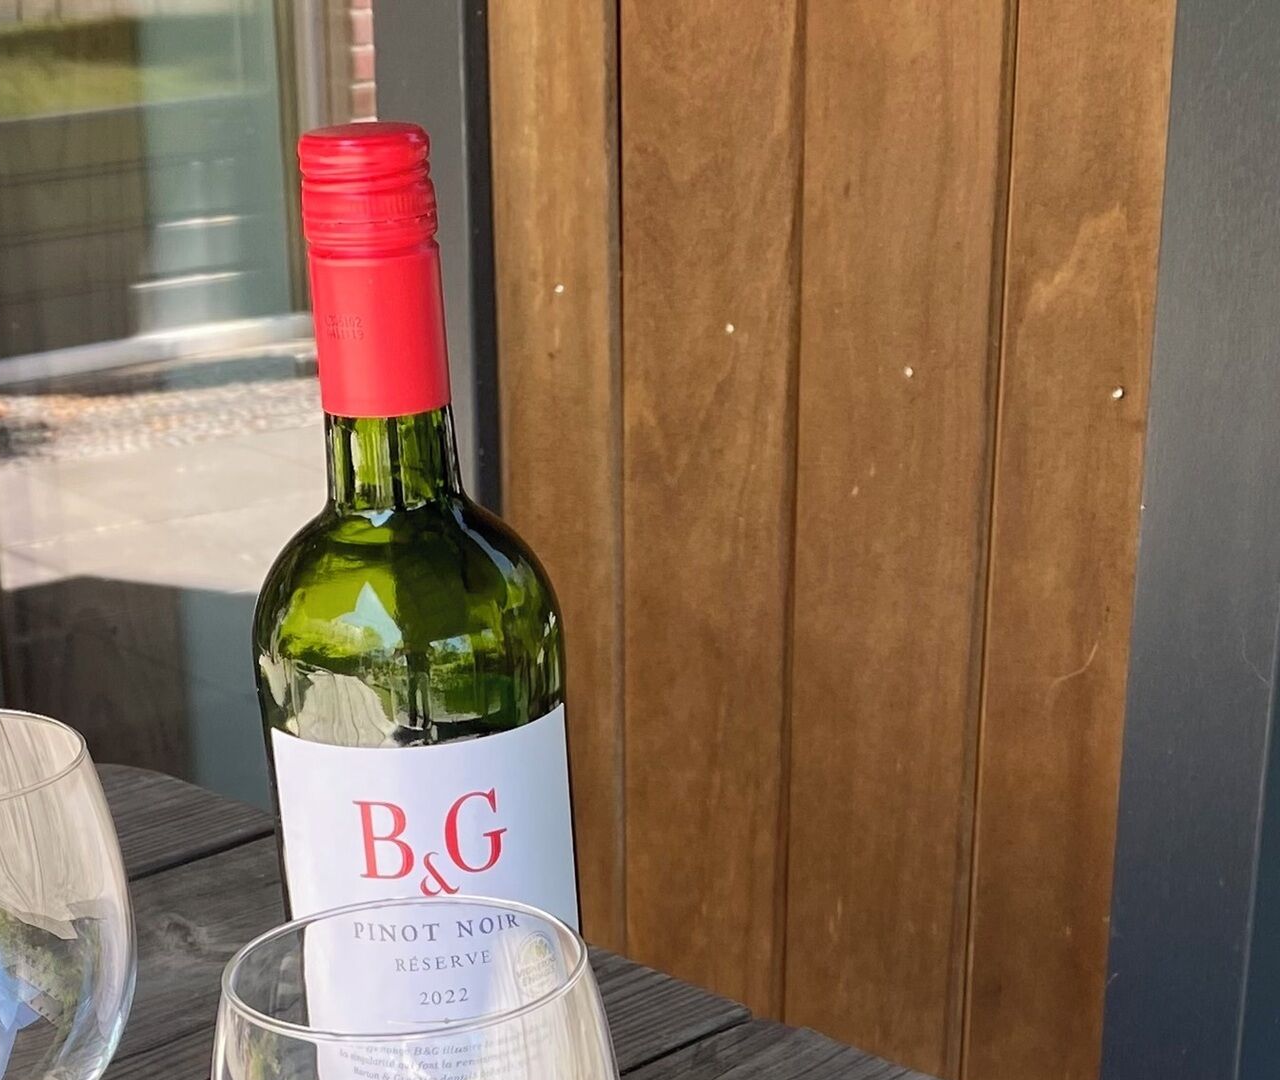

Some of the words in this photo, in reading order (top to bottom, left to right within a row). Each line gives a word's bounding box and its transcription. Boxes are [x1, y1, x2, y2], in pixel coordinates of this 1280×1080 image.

[353, 787, 507, 896] B&G
[354, 921, 441, 942] PINOT
[456, 913, 520, 938] NOIR
[395, 950, 492, 973] RÉSERVE
[419, 987, 469, 1006] 2022
